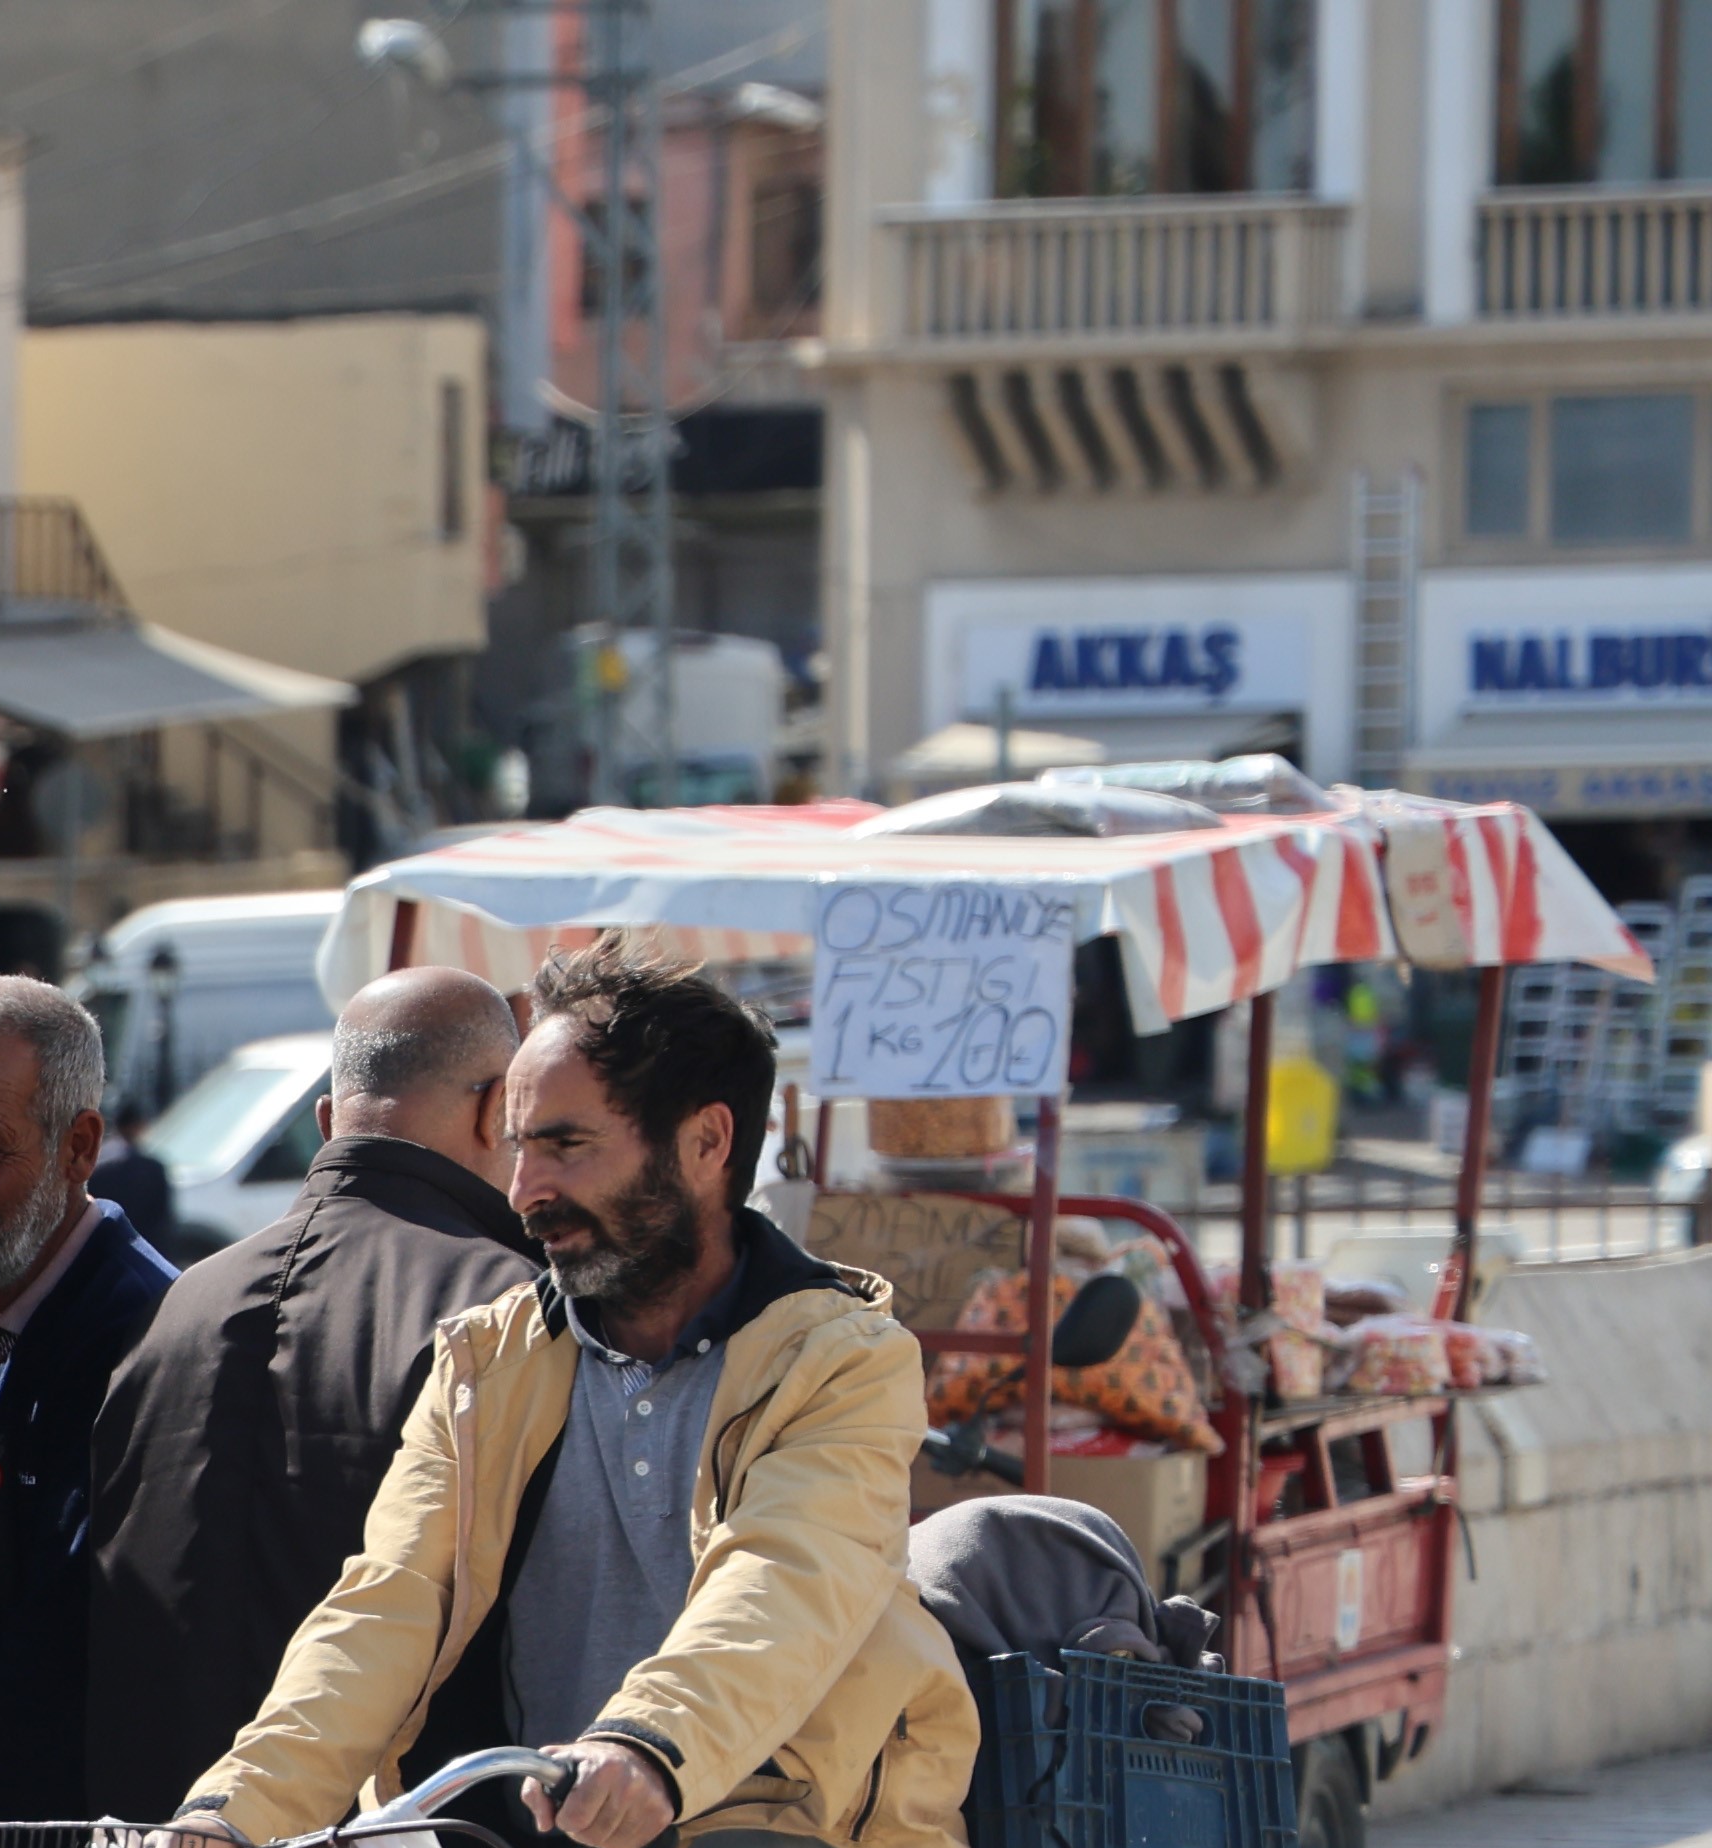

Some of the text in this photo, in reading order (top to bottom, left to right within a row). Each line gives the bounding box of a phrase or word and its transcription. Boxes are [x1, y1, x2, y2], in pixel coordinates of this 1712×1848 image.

[1029, 630, 1241, 706] AKKAŞ
[820, 1001, 1058, 1090] 1 KG 100
